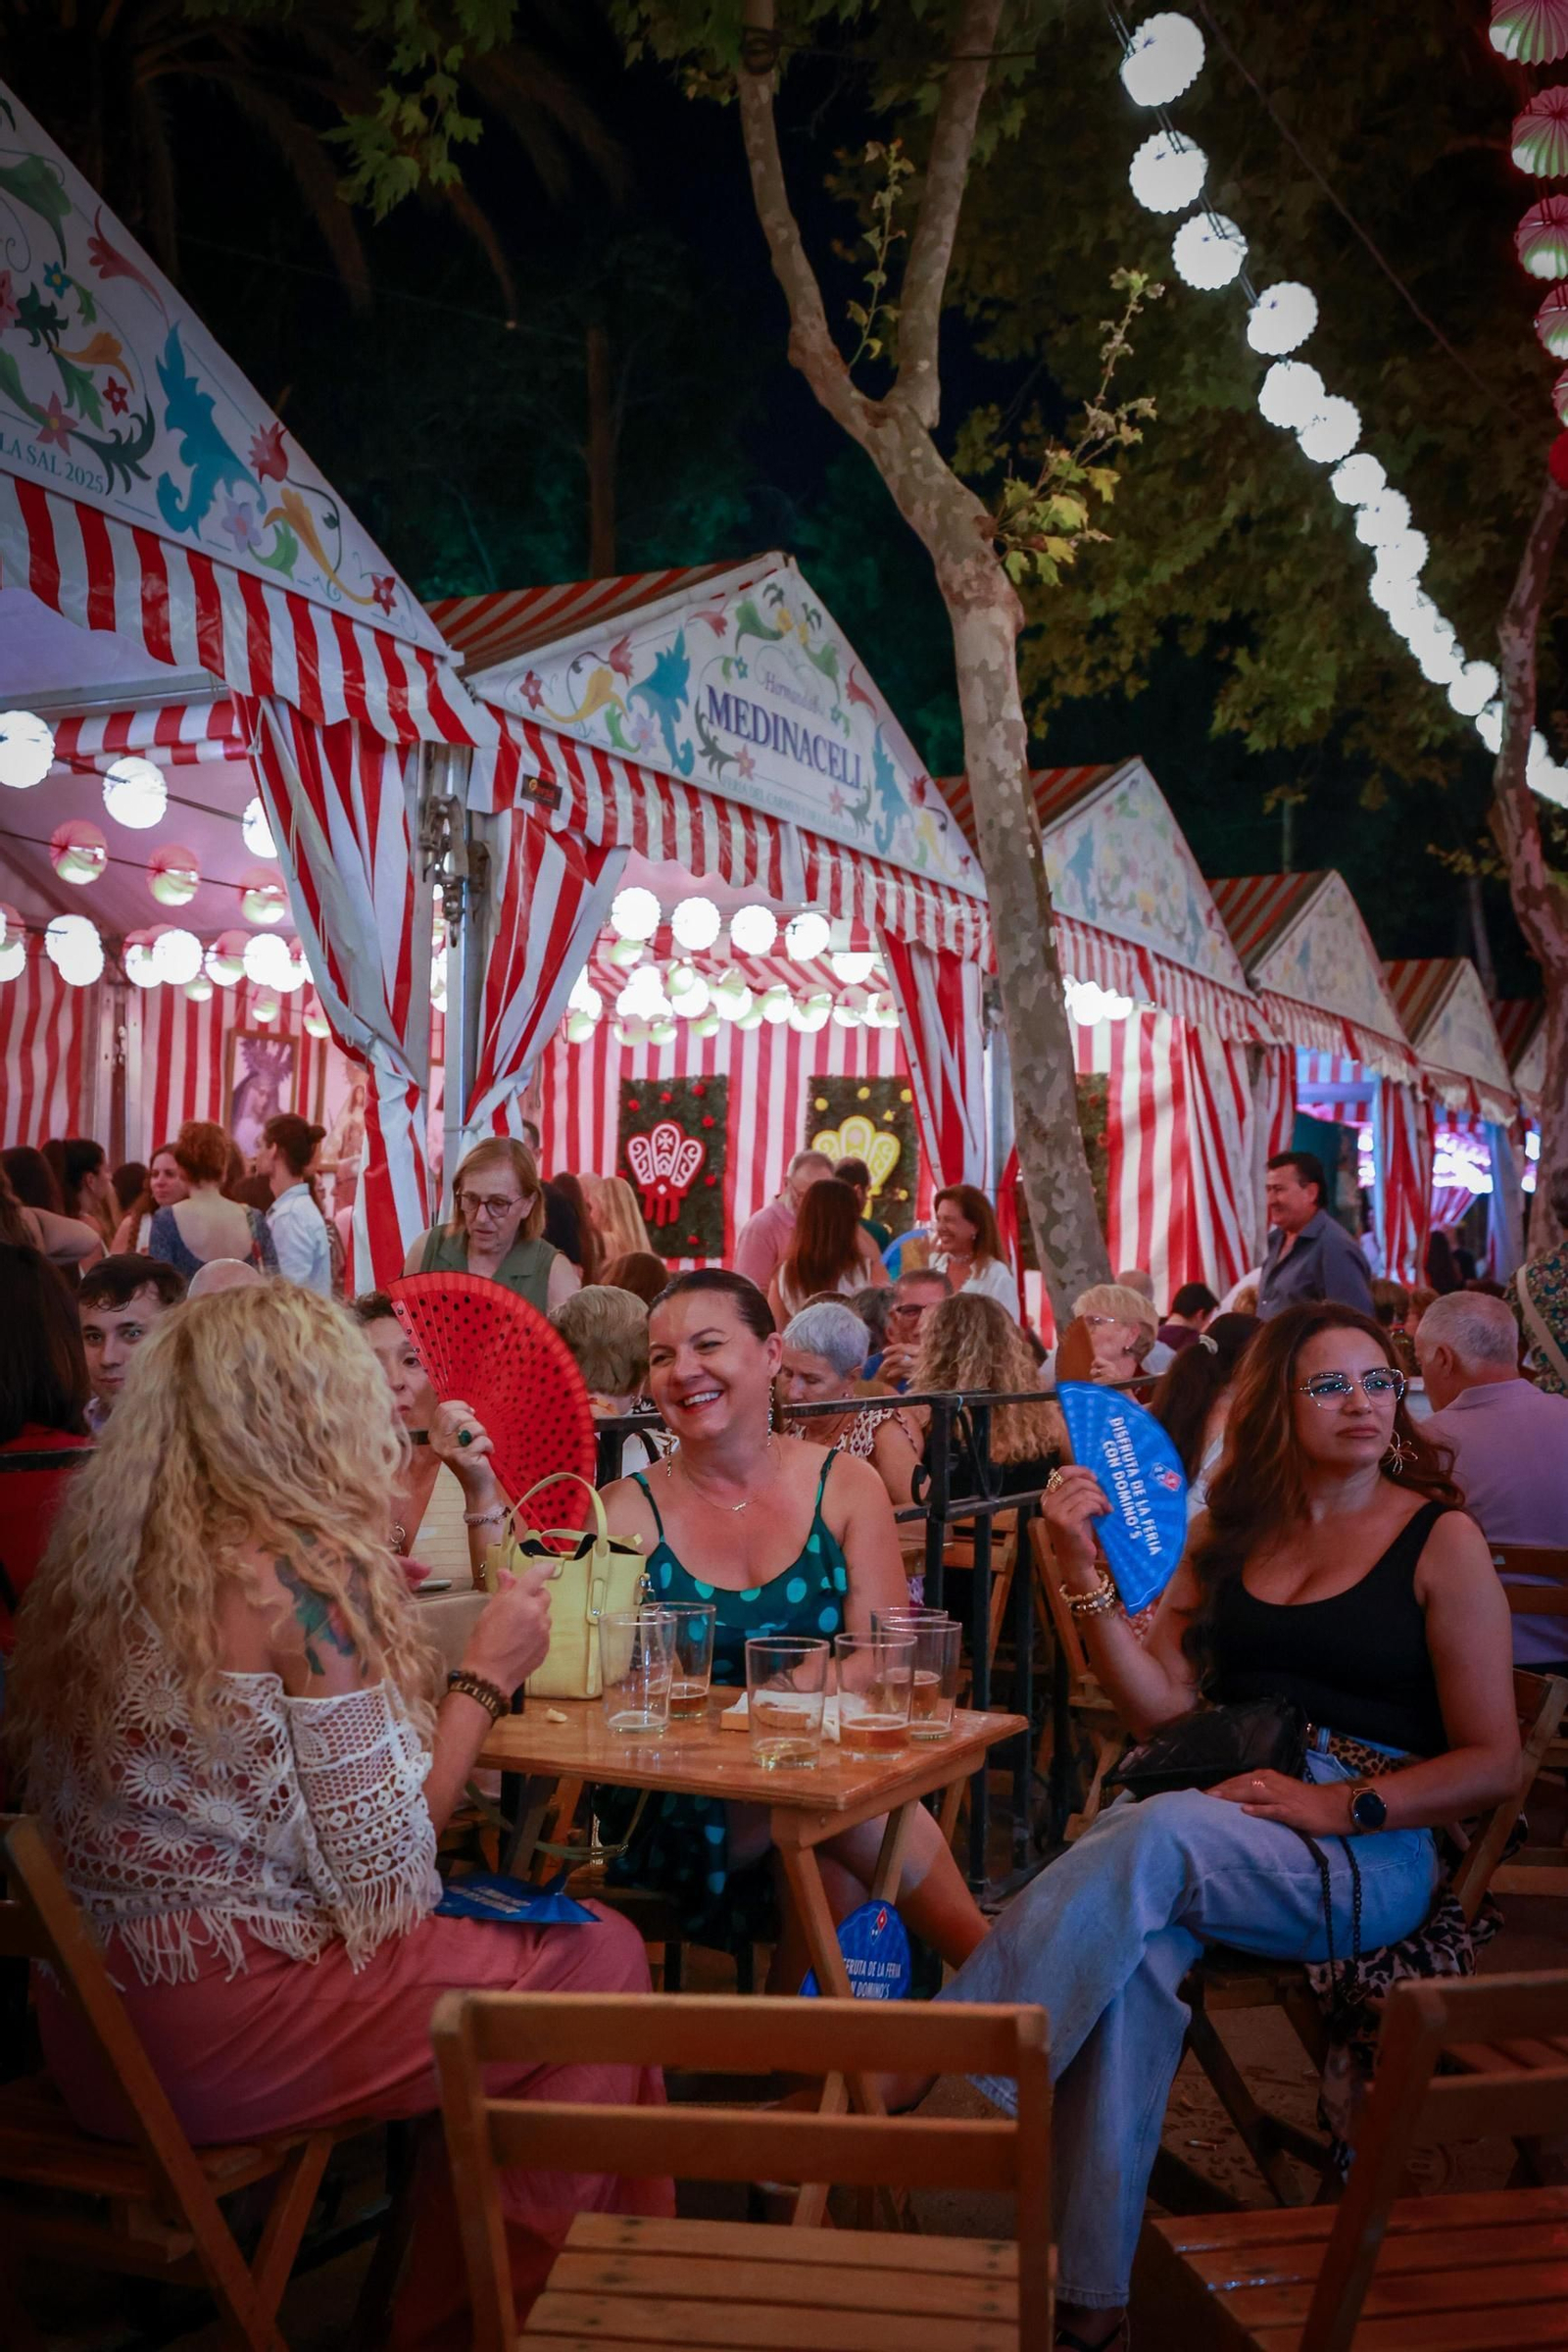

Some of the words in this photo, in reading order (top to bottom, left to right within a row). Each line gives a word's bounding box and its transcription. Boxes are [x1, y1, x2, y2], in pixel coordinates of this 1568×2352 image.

[0, 432, 22, 460] LA
[25, 445, 62, 475] SAL
[65, 462, 104, 494] 2025
[706, 684, 860, 790] MEDINACELI
[1102, 1440, 1122, 1468] CON
[1108, 1416, 1140, 1478] DISFRUTA
[1111, 1471, 1143, 1540] DOMINO'S
[1130, 1480, 1147, 1496] DE
[1135, 1499, 1152, 1516] LA
[1141, 1518, 1162, 1555] FERIA
[844, 1958, 866, 1977] FRUTA
[868, 1961, 877, 1977] DE
[877, 1962, 885, 1978] LA
[885, 1962, 902, 1979] FERIA
